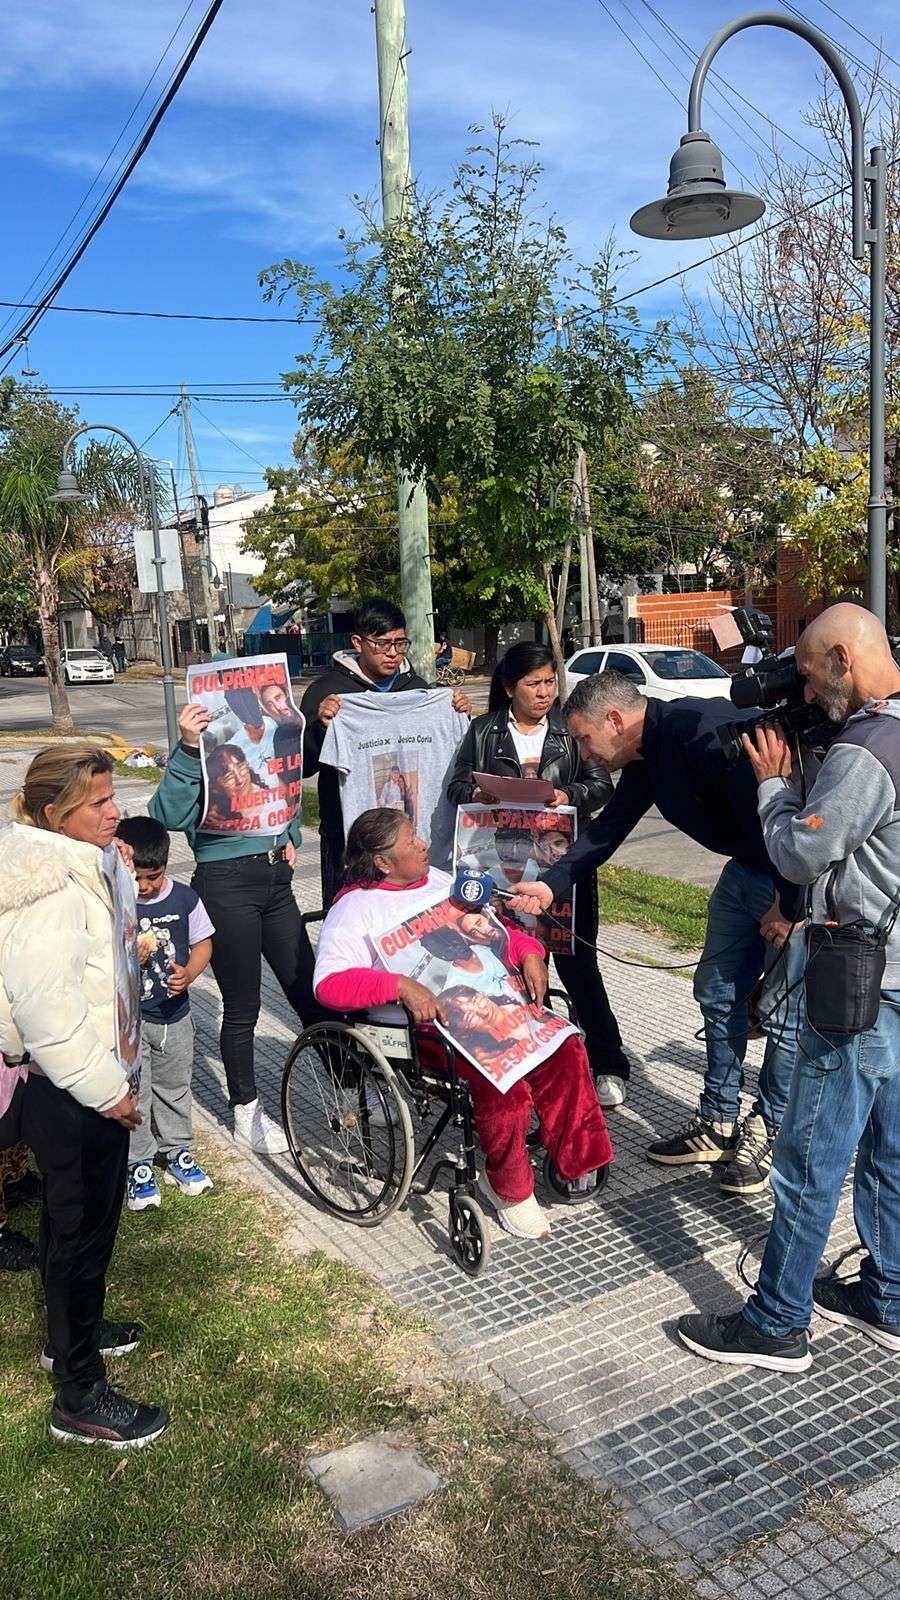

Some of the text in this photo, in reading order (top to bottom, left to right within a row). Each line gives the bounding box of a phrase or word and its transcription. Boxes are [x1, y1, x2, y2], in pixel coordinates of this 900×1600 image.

[357, 739, 383, 750] Justicia
[416, 734, 433, 744] Coria
[267, 753, 301, 775] DE LA
[551, 902, 572, 918] LA
